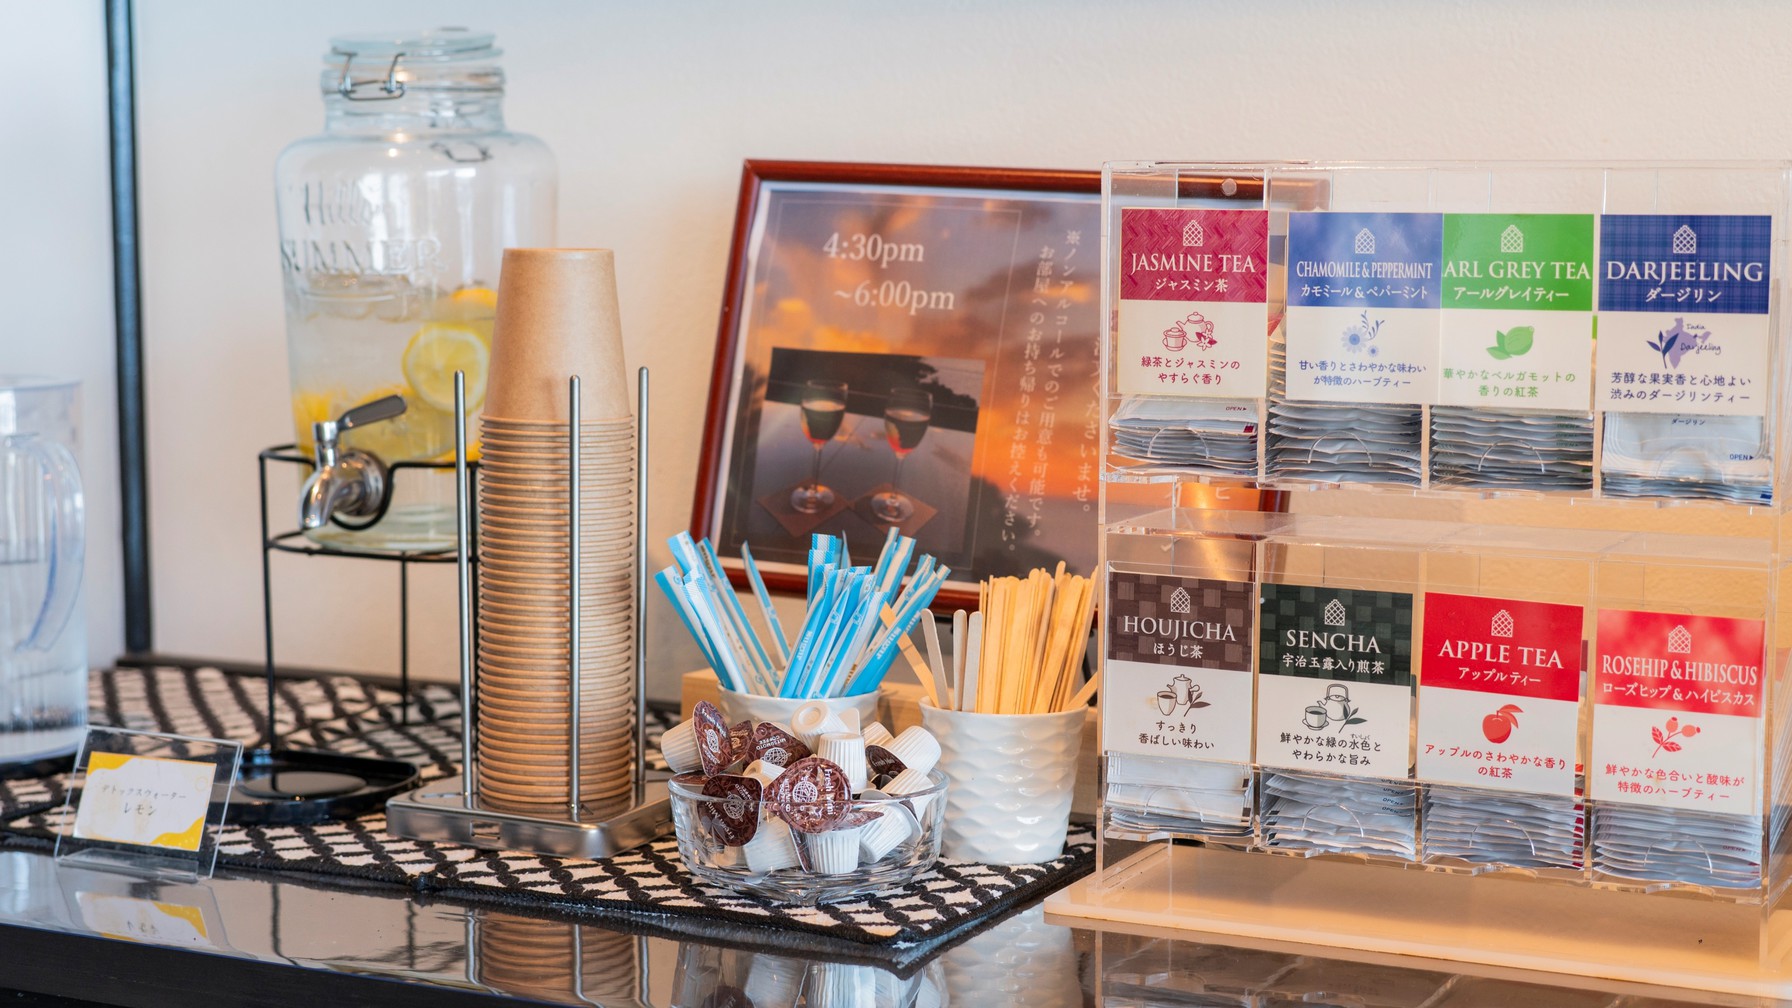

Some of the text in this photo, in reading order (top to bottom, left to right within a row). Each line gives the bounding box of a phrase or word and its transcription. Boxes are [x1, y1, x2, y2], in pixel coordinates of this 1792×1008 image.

[823, 232, 925, 268] 4:30pm
[1130, 253, 1256, 275] JASMINE TEA
[1296, 260, 1433, 279] CHAMOMILE & PEPPERMINT
[1442, 261, 1591, 280] ARL GREY TEA
[1606, 260, 1763, 285] DARJEELING
[1155, 278, 1229, 292] ジャスミン茶
[1453, 286, 1569, 302] アールグレイティー
[1645, 288, 1722, 303] ダージリン
[1141, 356, 1240, 370] 緑茶とジャスミンの
[1299, 360, 1427, 374] 甘い香りとさわやかな味わい
[1158, 373, 1222, 385] やすらぐ香り
[1313, 375, 1411, 388] が特徴のハーブティー
[1443, 368, 1576, 382] 華やかなベルガモットの
[1611, 372, 1752, 387] 芳醇な果実香と心地よい
[1001, 245, 1055, 552] お部屋へのお持ち帰りはお控えください。
[1478, 385, 1539, 398] 香りの紅茶
[1610, 388, 1750, 403] 渋みのダージリンティー
[1729, 453, 1749, 461] OPEN
[1123, 615, 1236, 642] HOUJICHA
[1286, 629, 1382, 654] SENCHA
[1153, 643, 1204, 659] ほうじ茶
[1438, 639, 1564, 670] APPLE TEA
[1282, 653, 1386, 676] 宇治玉露入り煎茶
[1602, 654, 1757, 686] ROSEHIP & HIBISCUS
[1457, 666, 1542, 686] アップルティー
[1156, 720, 1197, 734] すっきり
[1138, 733, 1215, 750] 香ばしい味わい
[1279, 732, 1382, 752] 鮮やかな緑の水色と
[1292, 749, 1371, 767] やわらかな旨み
[1425, 744, 1567, 771] アップルのさわやかな香り
[824, 768, 834, 792] Fresh
[1478, 764, 1513, 779] の紅茶
[1605, 763, 1744, 787] 鮮やかな色合いと酸味が
[1617, 780, 1730, 801] 特徴のハーブティー
[124, 802, 157, 816] レモン
